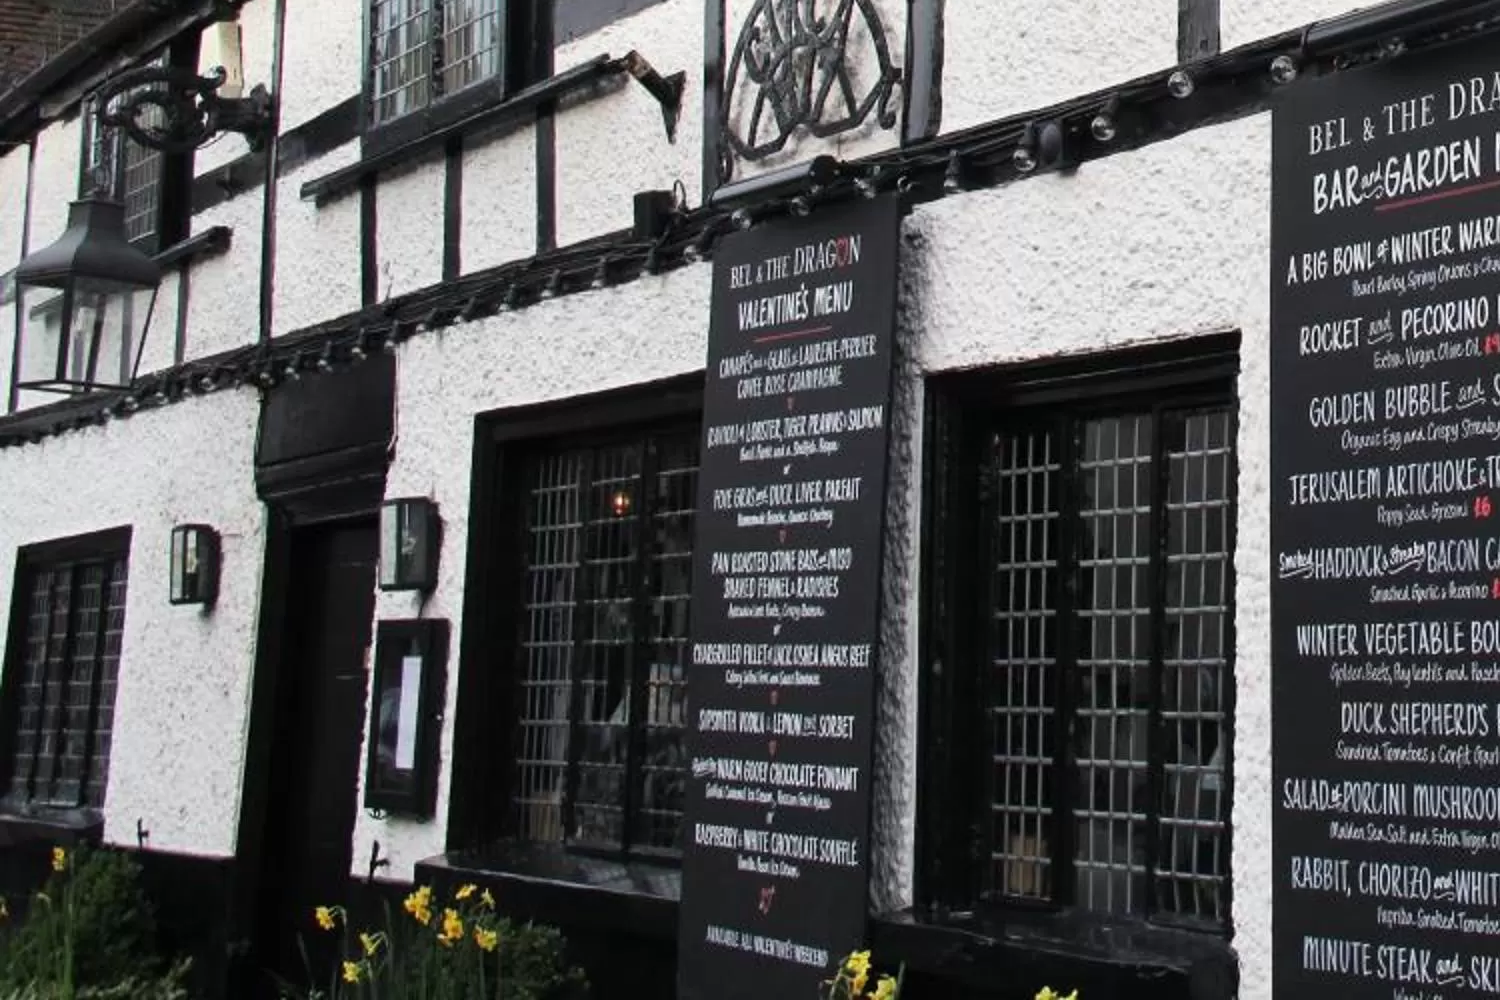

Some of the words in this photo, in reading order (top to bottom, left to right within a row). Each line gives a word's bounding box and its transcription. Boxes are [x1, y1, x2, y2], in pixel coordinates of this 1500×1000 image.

[1308, 117, 1350, 155] BEL
[1362, 117, 1376, 141] &
[1381, 94, 1435, 137] THE
[1313, 165, 1362, 214] BAR
[1360, 162, 1385, 194] and
[1383, 136, 1482, 198] GARDEN
[730, 263, 752, 289] BEL
[764, 255, 791, 282] THE
[793, 234, 862, 274] DRAGON
[1287, 256, 1298, 286] A
[1302, 250, 1327, 283] BIG
[1333, 240, 1377, 277] BOWL
[1390, 225, 1454, 264] WINTER
[1407, 267, 1437, 290] Spring
[1438, 262, 1471, 283] Onions
[738, 284, 809, 331] VALENTINE'S
[813, 280, 853, 317] MENU
[1300, 316, 1363, 356] ROCKET
[1367, 314, 1394, 341] and
[1401, 296, 1490, 341] PECORINO
[1310, 390, 1375, 427] GOLDEN
[1385, 381, 1451, 419] BUBBLE
[1457, 379, 1486, 406] and
[1341, 429, 1381, 455] Organic
[1383, 427, 1403, 450] Egg
[1427, 422, 1459, 444] Crispy
[1461, 414, 1500, 440] Streaky
[1289, 466, 1381, 504] JERUSALEM
[1386, 457, 1477, 498] ARTICHOKE
[1315, 545, 1384, 579] HADDOCK
[1427, 538, 1479, 573] BACON
[1297, 624, 1359, 656] WINTER
[1364, 621, 1465, 655] VEGETABLE
[818, 714, 855, 739] SORBET
[1341, 701, 1387, 734] DUCK
[1283, 778, 1329, 811] SALAD
[1343, 780, 1407, 815] PORCINI
[1291, 856, 1351, 897] RABBIT,
[1359, 861, 1432, 900] CHORIZO
[1303, 935, 1372, 975] MINUTE
[1377, 944, 1434, 984] STEAK
[1436, 952, 1464, 980] and
